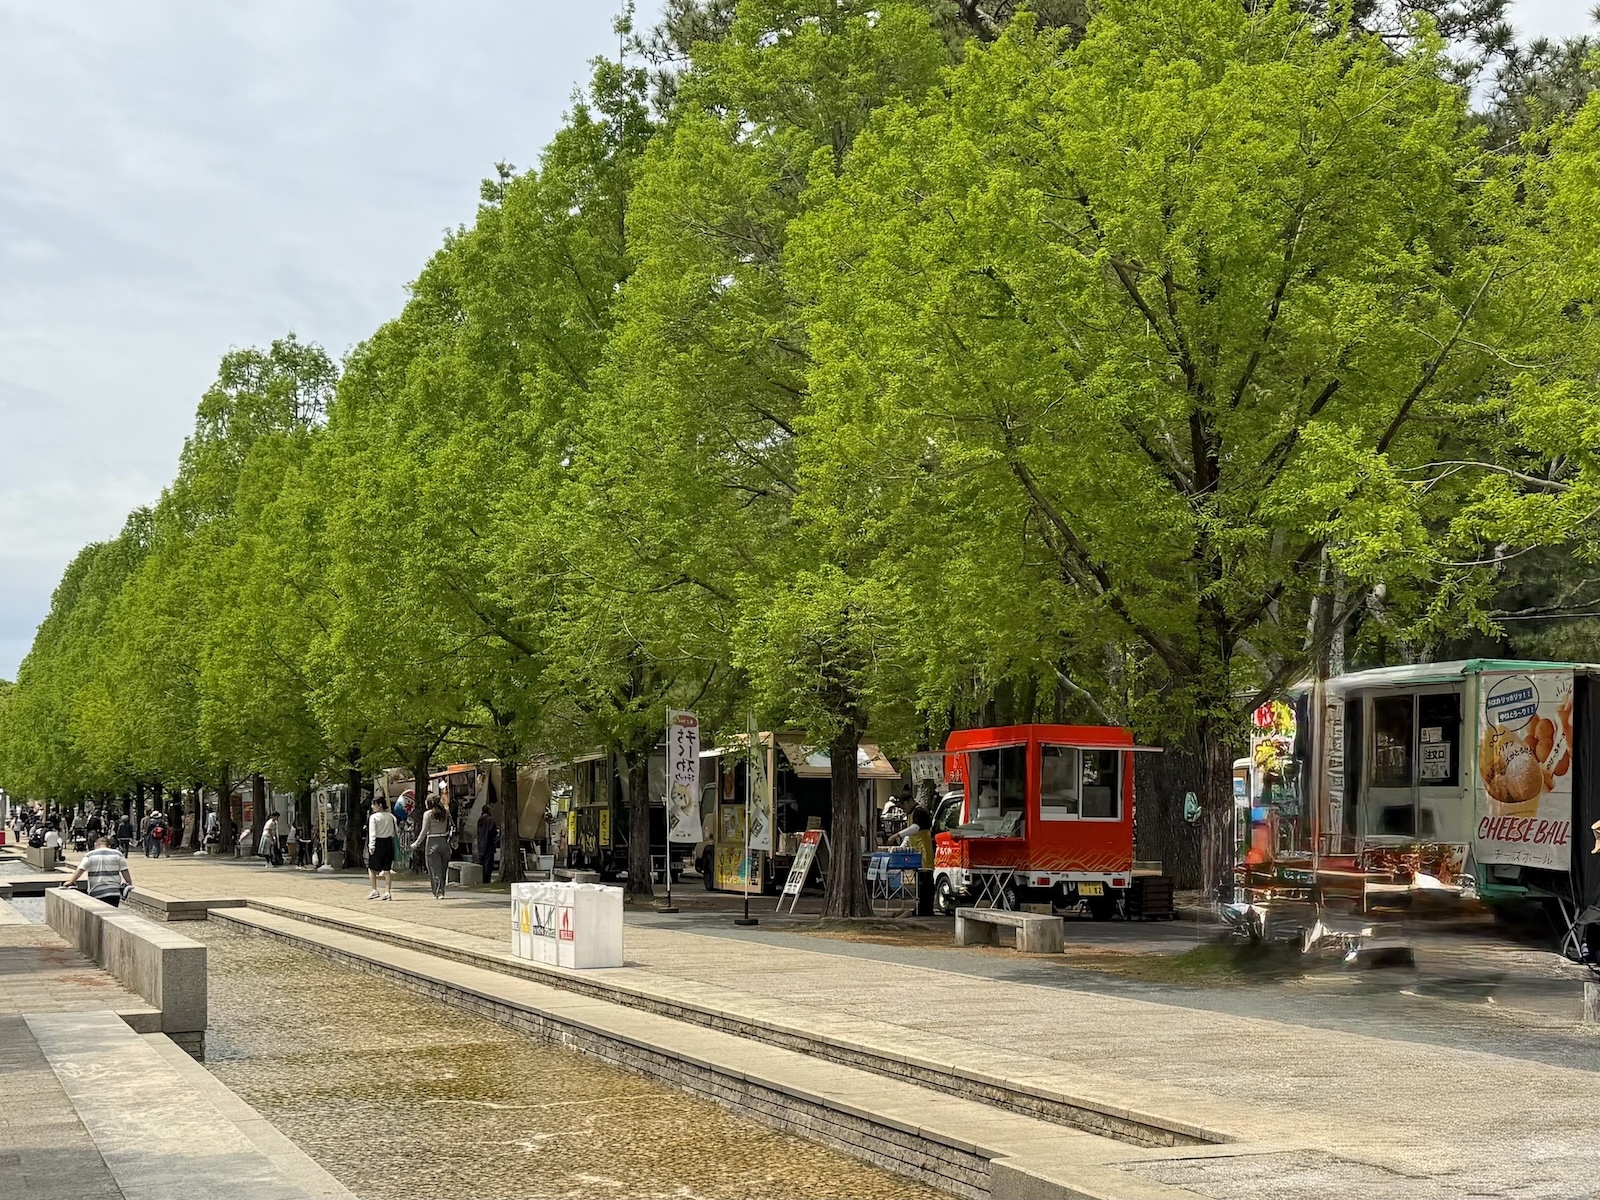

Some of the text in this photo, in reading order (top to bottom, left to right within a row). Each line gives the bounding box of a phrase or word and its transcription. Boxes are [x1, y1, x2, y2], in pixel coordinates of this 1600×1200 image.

[1424, 750, 1445, 760] 注文口
[1477, 816, 1570, 846] CHEESE BALL
